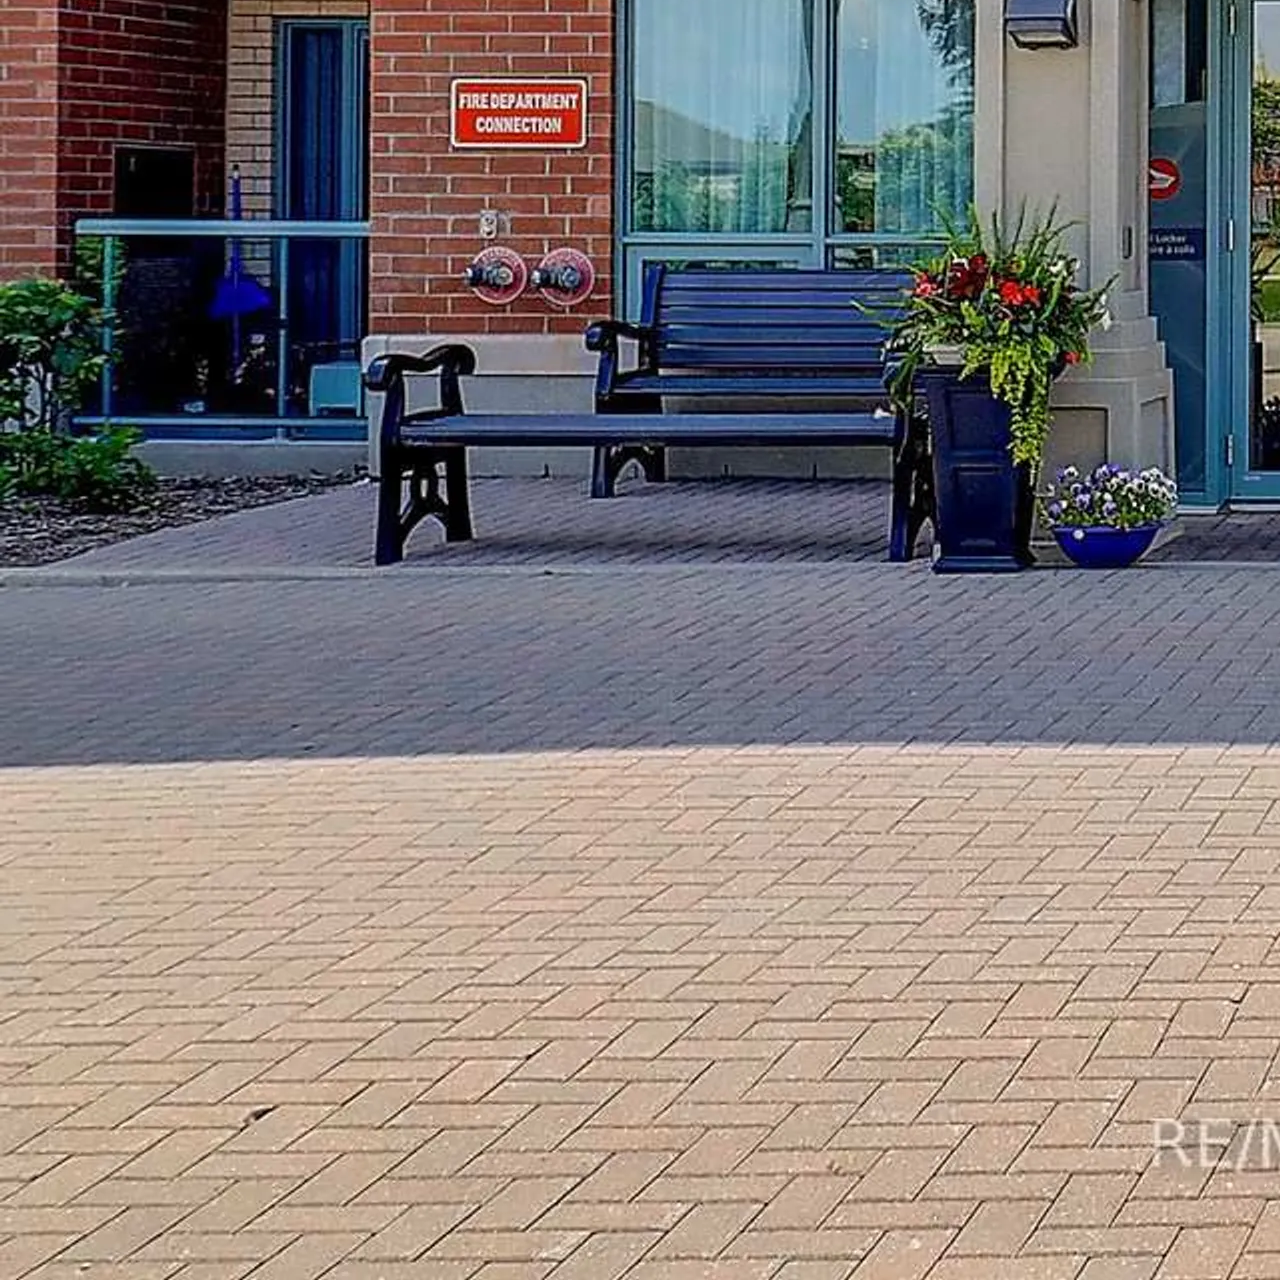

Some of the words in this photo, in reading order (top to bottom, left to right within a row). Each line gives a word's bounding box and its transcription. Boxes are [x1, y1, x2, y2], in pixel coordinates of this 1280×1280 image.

[459, 93, 489, 109] FIRE
[490, 93, 578, 109] DEPARTMENT
[476, 117, 562, 133] CONNECTION
